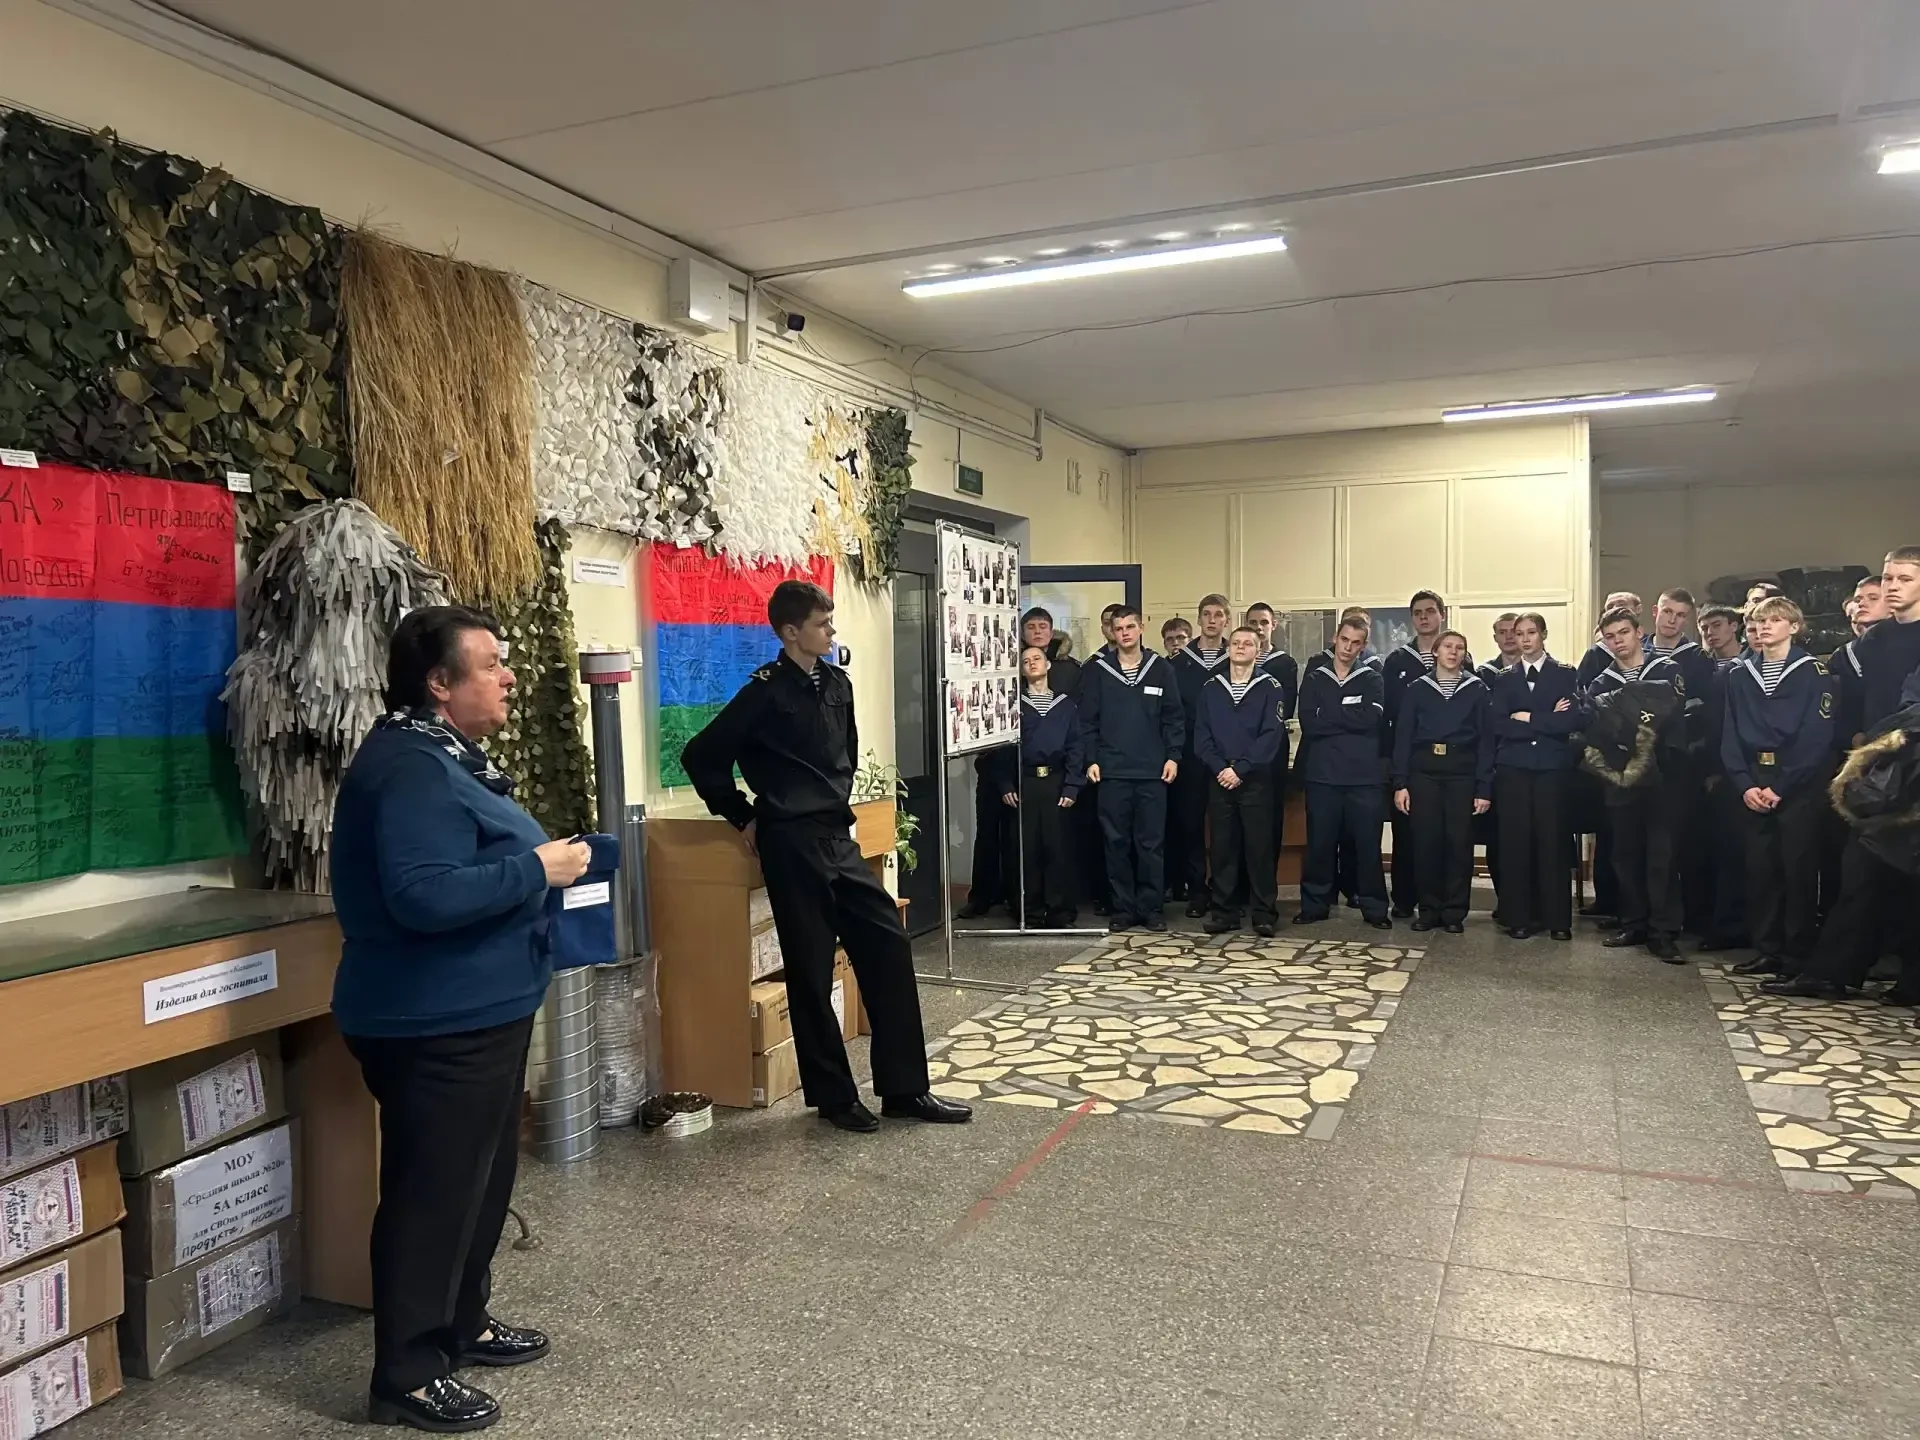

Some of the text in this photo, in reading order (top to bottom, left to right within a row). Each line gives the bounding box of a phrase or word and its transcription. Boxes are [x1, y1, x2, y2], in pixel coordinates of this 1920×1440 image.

[156, 972, 269, 1011] Изделия для госпиталя
[224, 1151, 256, 1174] МОУ
[182, 1183, 229, 1206] «Средняя
[231, 1171, 260, 1188] школа
[213, 1183, 270, 1216] 5А класс
[193, 1227, 209, 1240] для
[210, 1214, 239, 1232] СВОих
